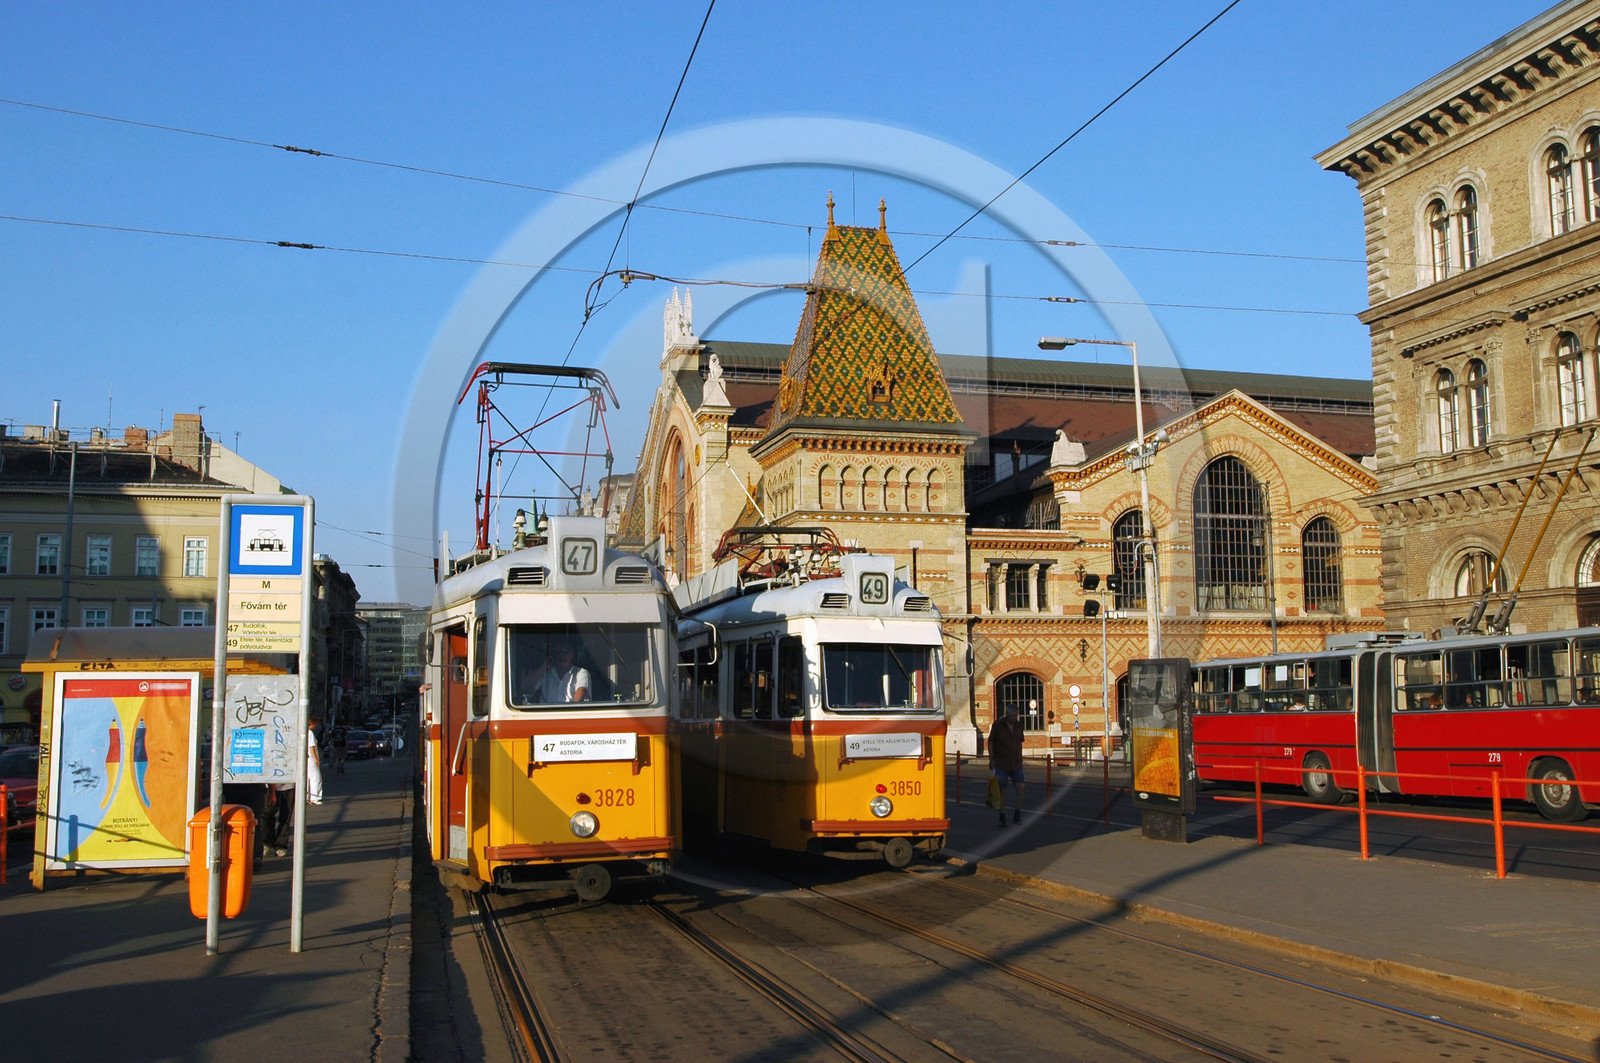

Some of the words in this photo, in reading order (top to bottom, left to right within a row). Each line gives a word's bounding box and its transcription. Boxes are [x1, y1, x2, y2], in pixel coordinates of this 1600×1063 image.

[567, 546, 592, 571] 47
[261, 580, 271, 589] M
[863, 579, 883, 599] 49
[240, 601, 272, 610] Fővám
[274, 602, 288, 610] tér
[227, 624, 239, 633] 47
[226, 639, 238, 647] 49
[587, 738, 616, 746] VÁROSHÁZ
[849, 742, 860, 750] 49
[542, 743, 556, 752] 47
[1284, 747, 1293, 756] 279
[1488, 753, 1501, 763] 279
[890, 780, 921, 796] 3850
[595, 788, 635, 807] 3828
